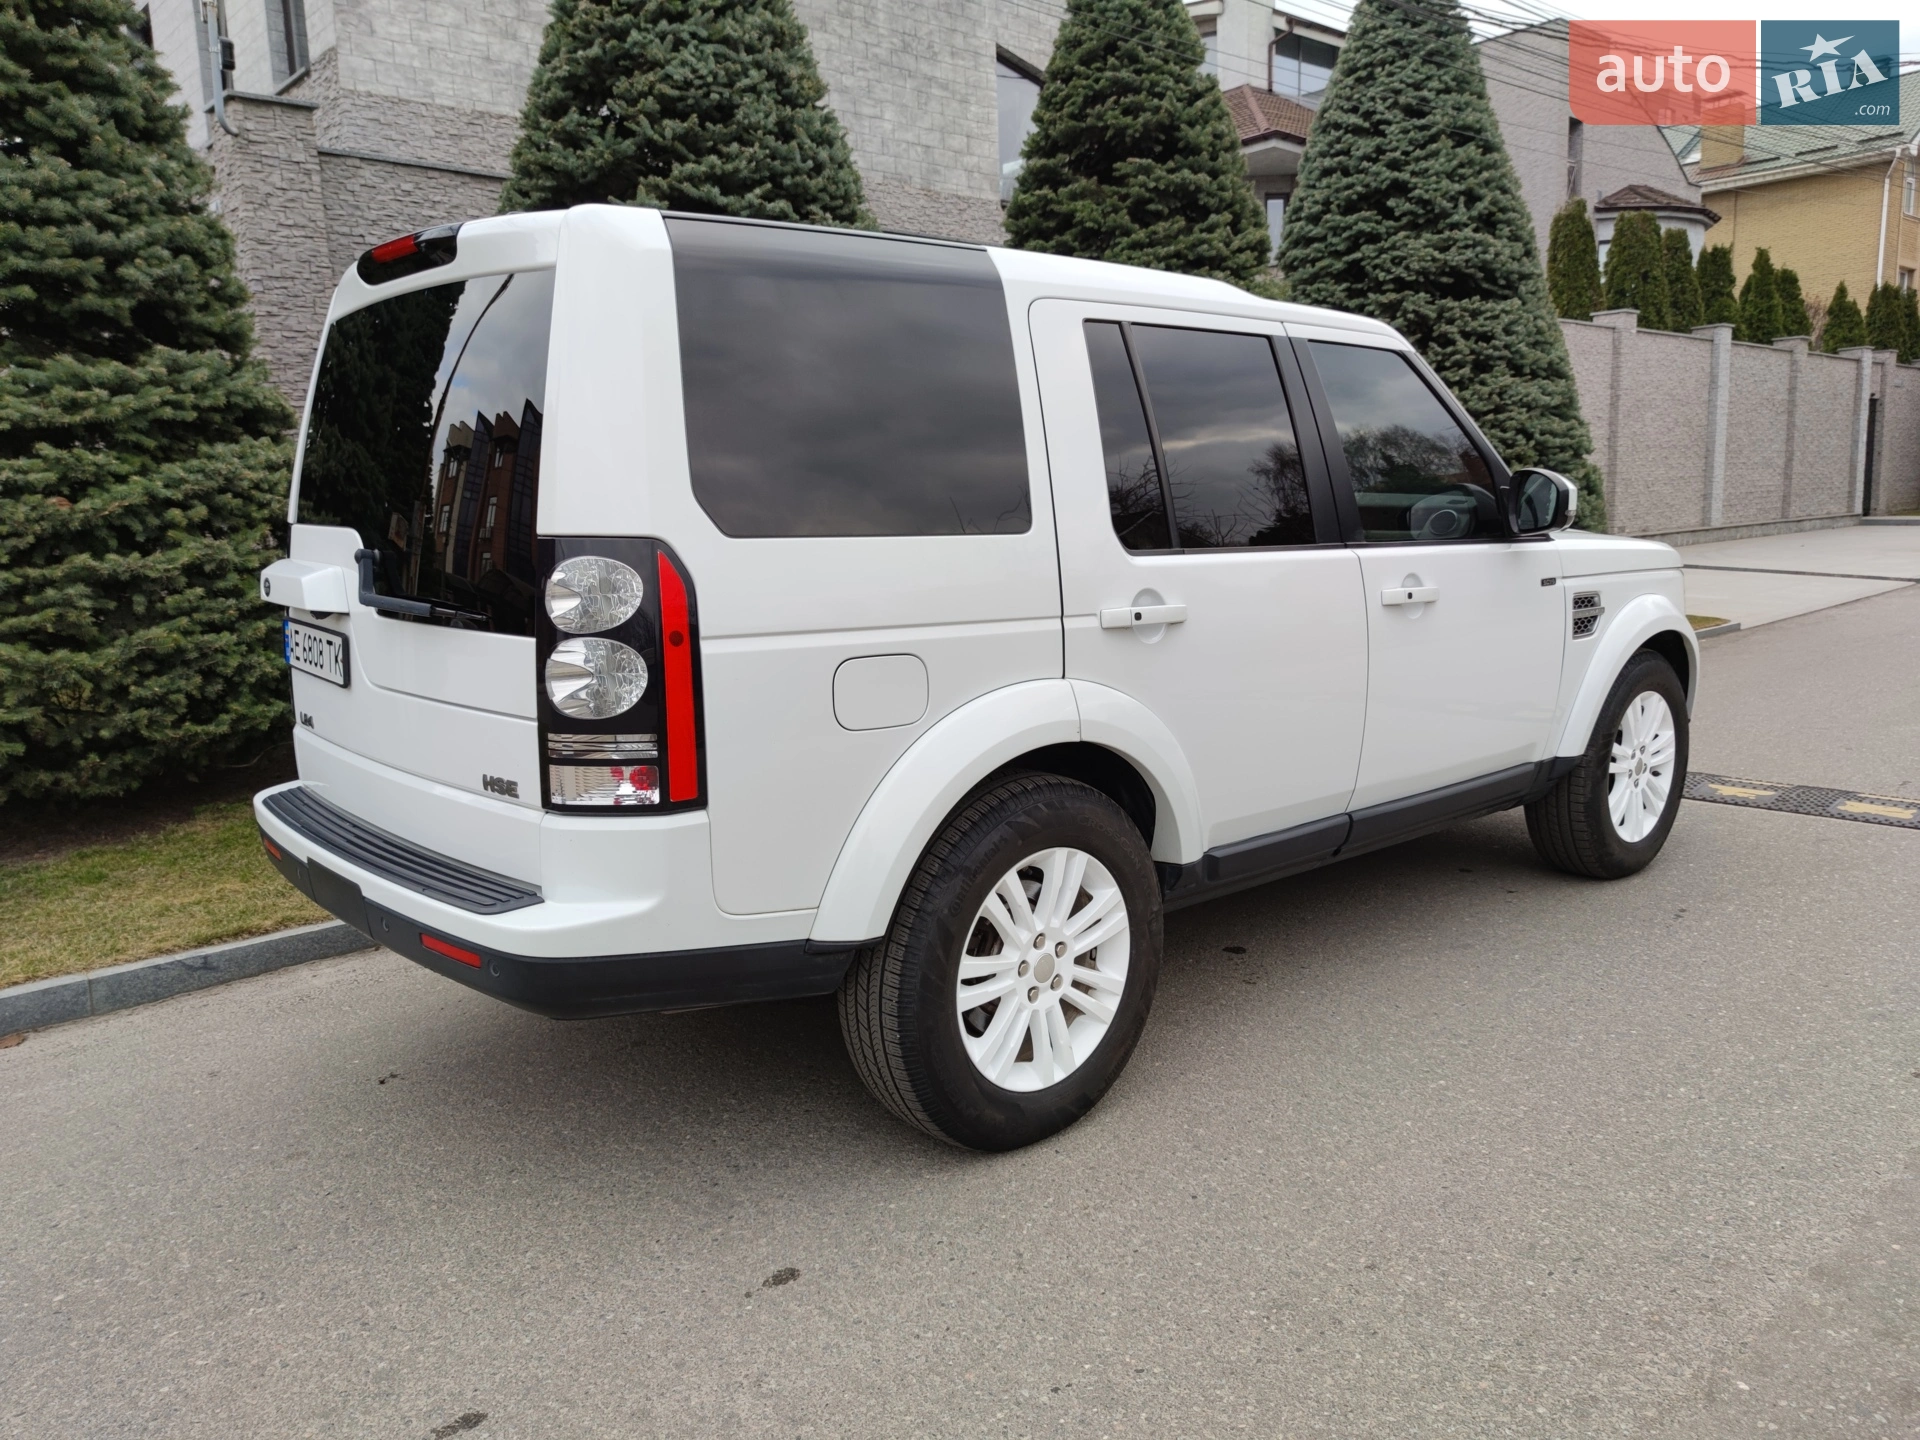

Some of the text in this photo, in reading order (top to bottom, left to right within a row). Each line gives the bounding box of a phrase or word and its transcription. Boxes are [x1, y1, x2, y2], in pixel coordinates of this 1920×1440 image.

[290, 628, 342, 677] AE 6808 TK
[482, 773, 519, 799] HSE
